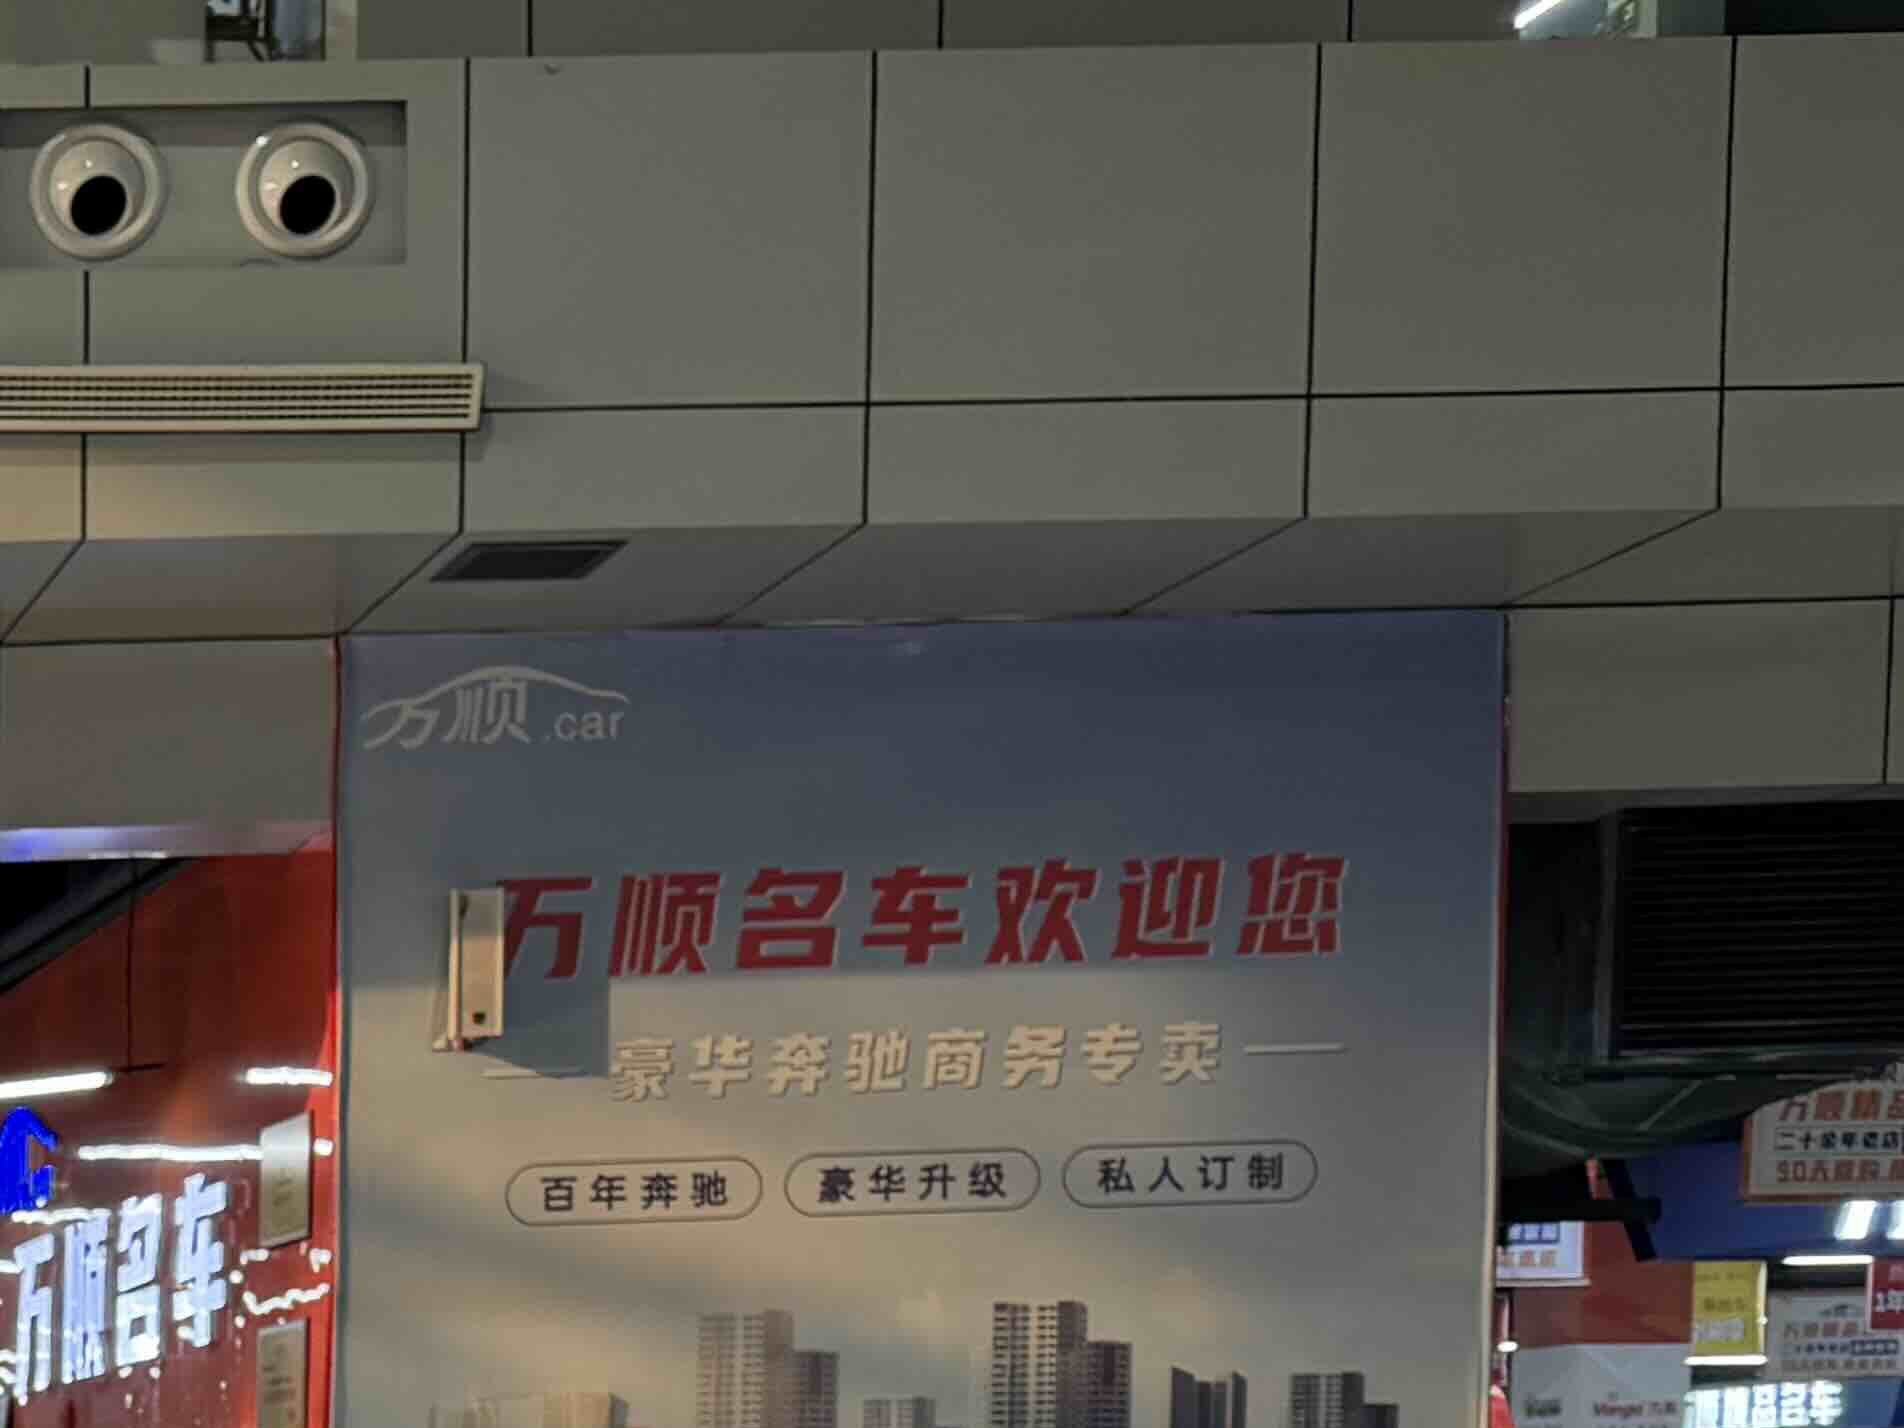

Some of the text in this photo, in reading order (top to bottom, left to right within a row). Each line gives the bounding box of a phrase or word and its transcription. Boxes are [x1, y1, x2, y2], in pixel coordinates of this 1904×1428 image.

[543, 704, 626, 745] .car
[494, 850, 1348, 982] 万顺名车欢迎您
[610, 1021, 1222, 1103] 豪华奔驰商务专卖
[540, 1169, 730, 1212] 百年奔驰
[817, 1161, 1009, 1205] 豪华升级
[1098, 1152, 1286, 1197] 私人订制
[14, 1173, 227, 1406] 万顺名车
